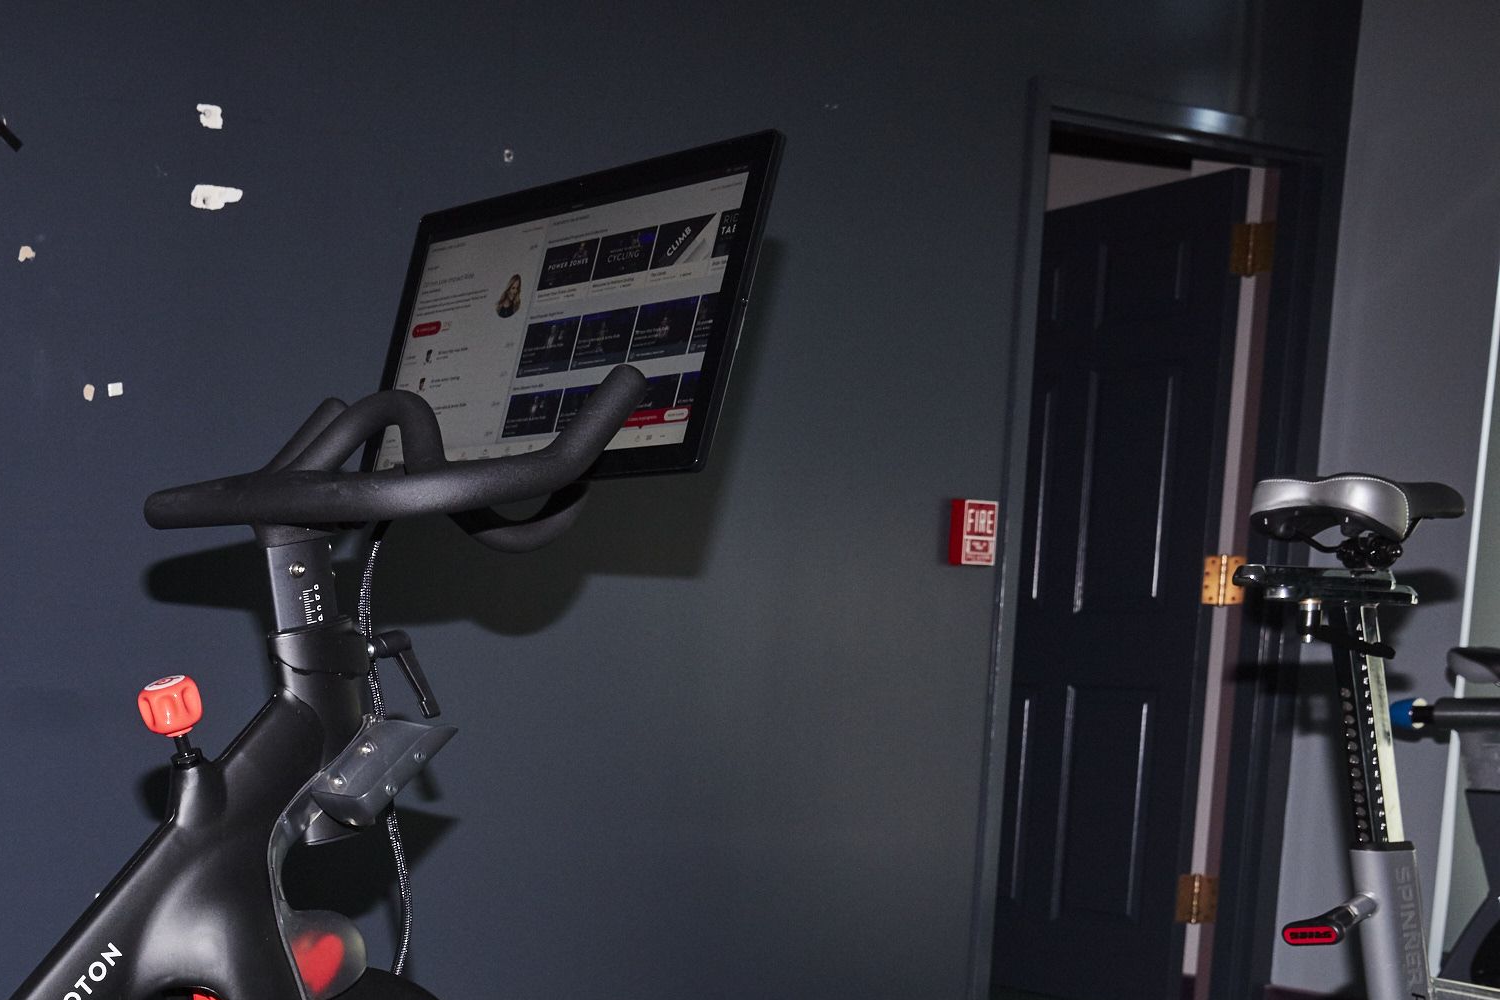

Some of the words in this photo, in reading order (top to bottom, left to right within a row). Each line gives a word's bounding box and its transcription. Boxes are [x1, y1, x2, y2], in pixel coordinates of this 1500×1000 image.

[666, 225, 692, 257] CLIMB
[607, 249, 641, 264] CYCLING
[966, 508, 995, 534] FIRE
[1396, 865, 1423, 989] SPINNER
